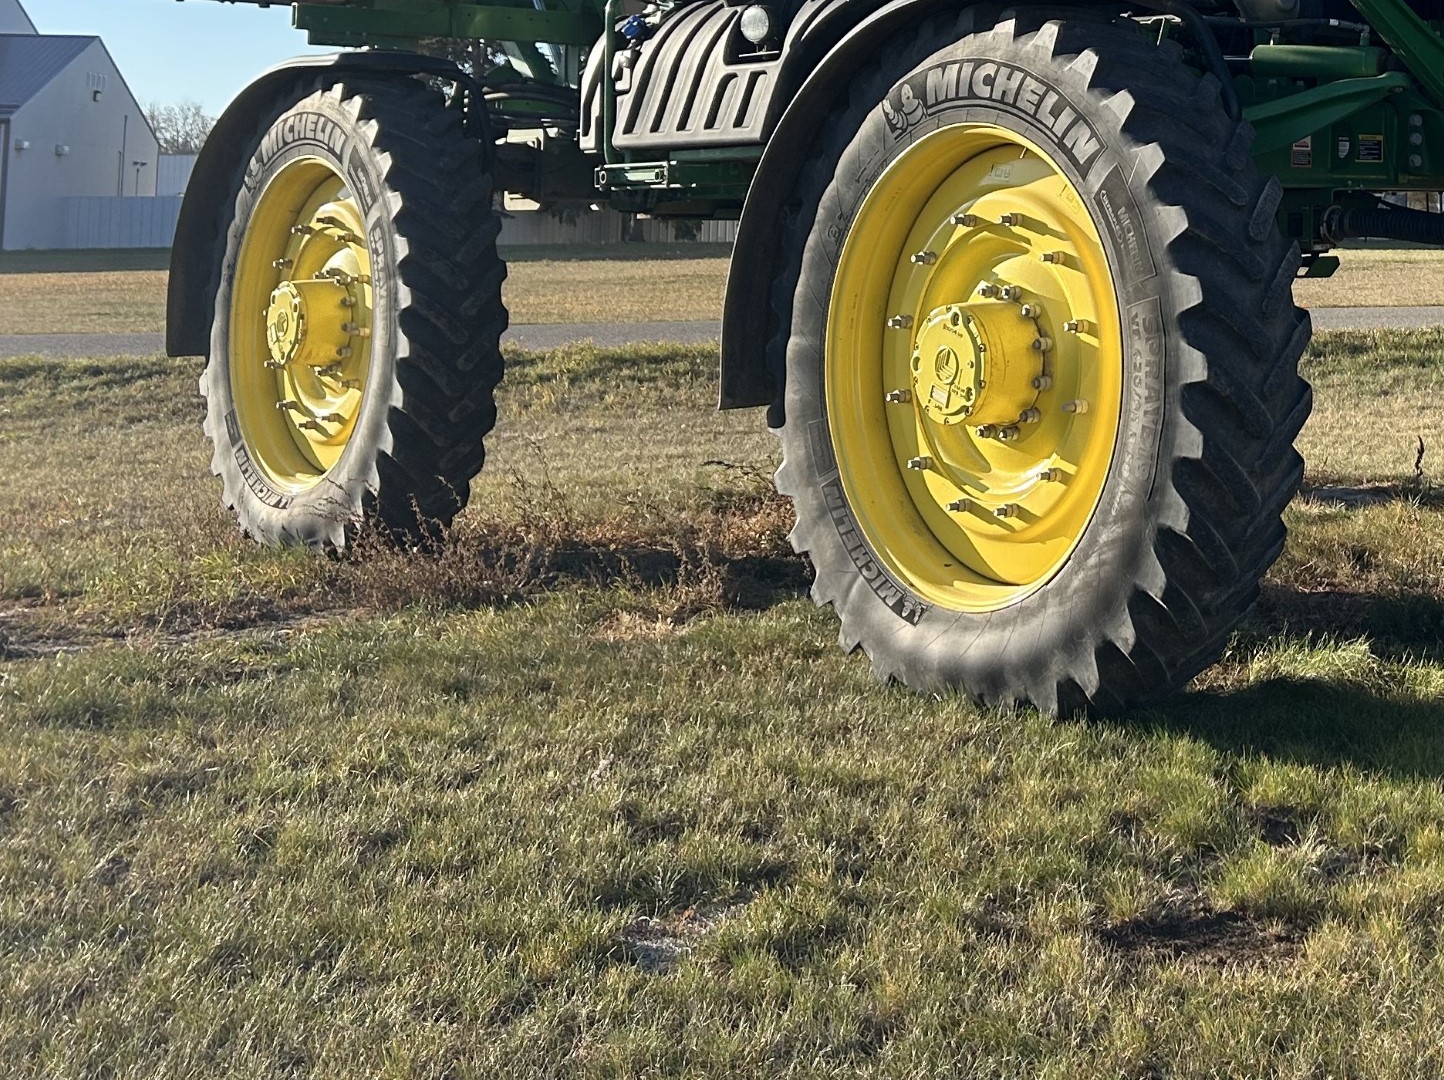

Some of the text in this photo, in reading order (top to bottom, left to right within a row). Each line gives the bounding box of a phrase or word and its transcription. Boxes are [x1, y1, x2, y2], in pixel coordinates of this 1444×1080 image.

[261, 113, 346, 164] MICHELIN
[925, 62, 1101, 165] MICHELIN
[1117, 206, 1144, 274] MICHELIN
[236, 448, 281, 506] MICHELIN
[824, 485, 902, 607] MICHELIN
